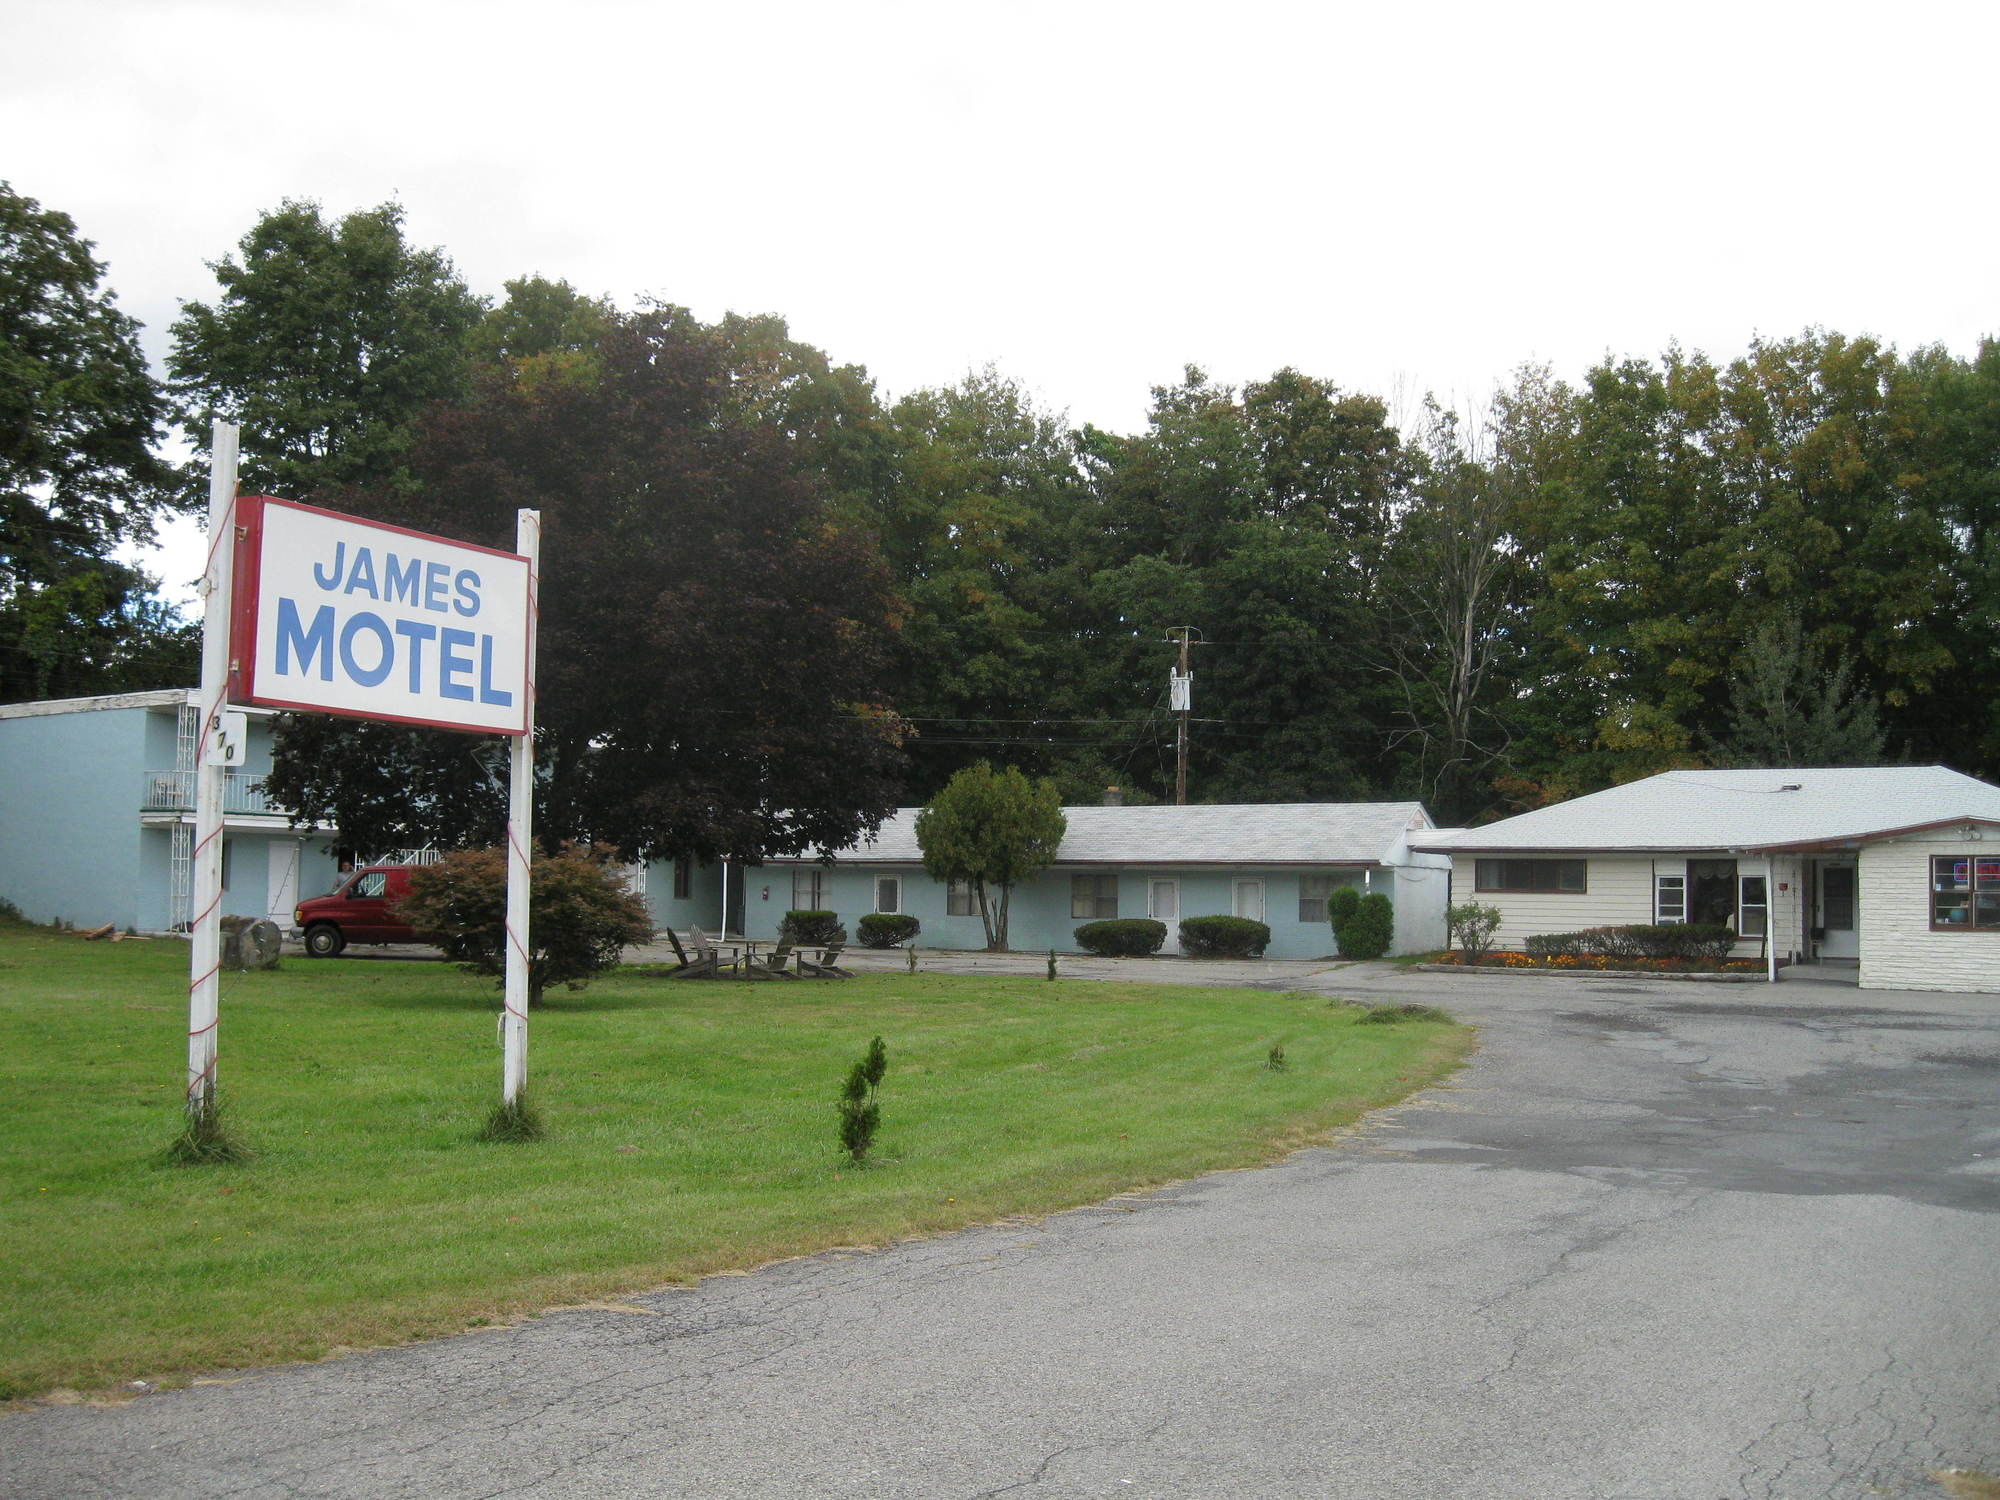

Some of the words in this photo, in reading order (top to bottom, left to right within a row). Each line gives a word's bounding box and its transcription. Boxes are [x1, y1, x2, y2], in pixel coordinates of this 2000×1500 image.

[313, 541, 481, 617] JAMES
[275, 597, 512, 707] MOTEL
[212, 716, 234, 760] 370
